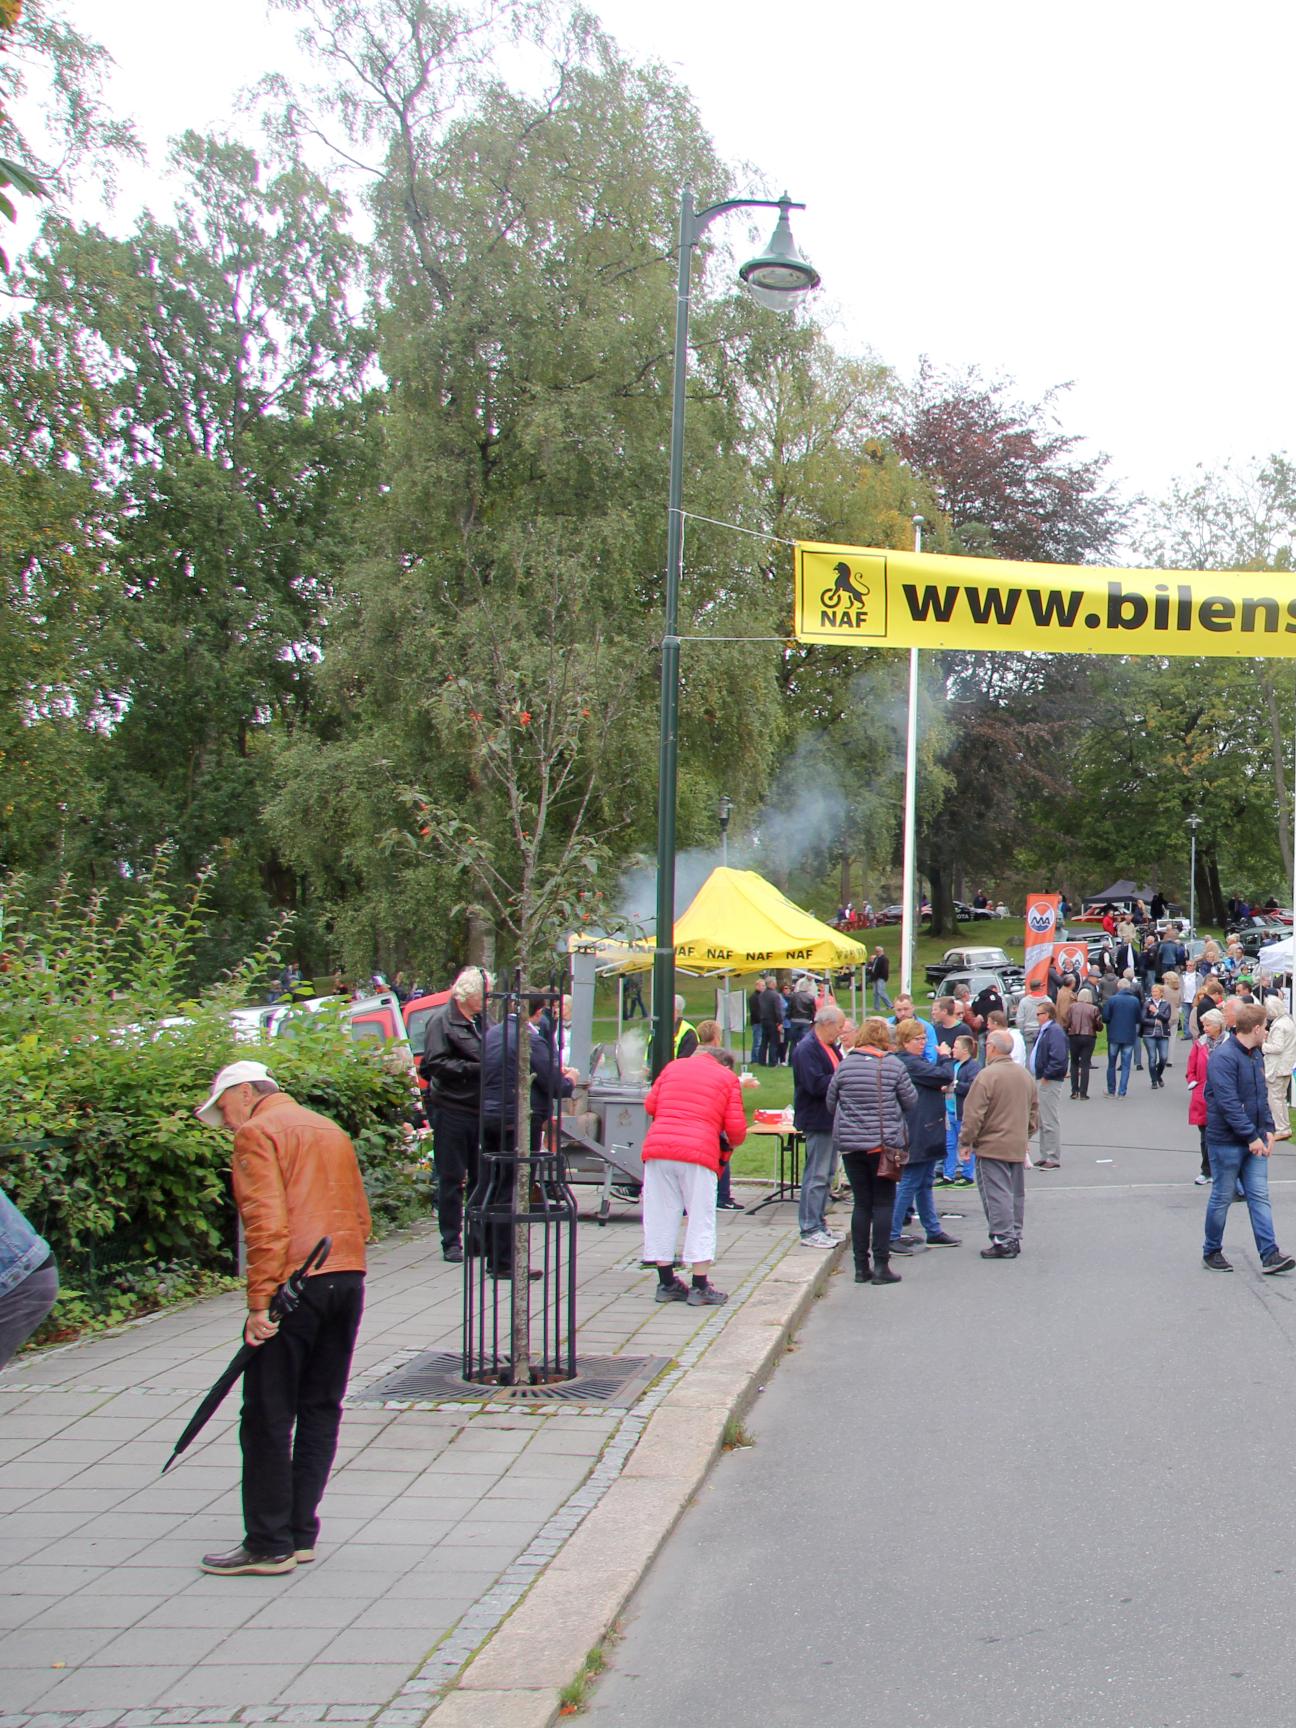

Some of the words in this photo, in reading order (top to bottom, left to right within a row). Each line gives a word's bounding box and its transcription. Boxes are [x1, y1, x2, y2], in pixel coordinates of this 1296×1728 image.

[821, 610, 868, 628] NAF
[707, 948, 734, 960] NAF
[746, 952, 773, 961] NAF
[786, 949, 813, 960] NAF
